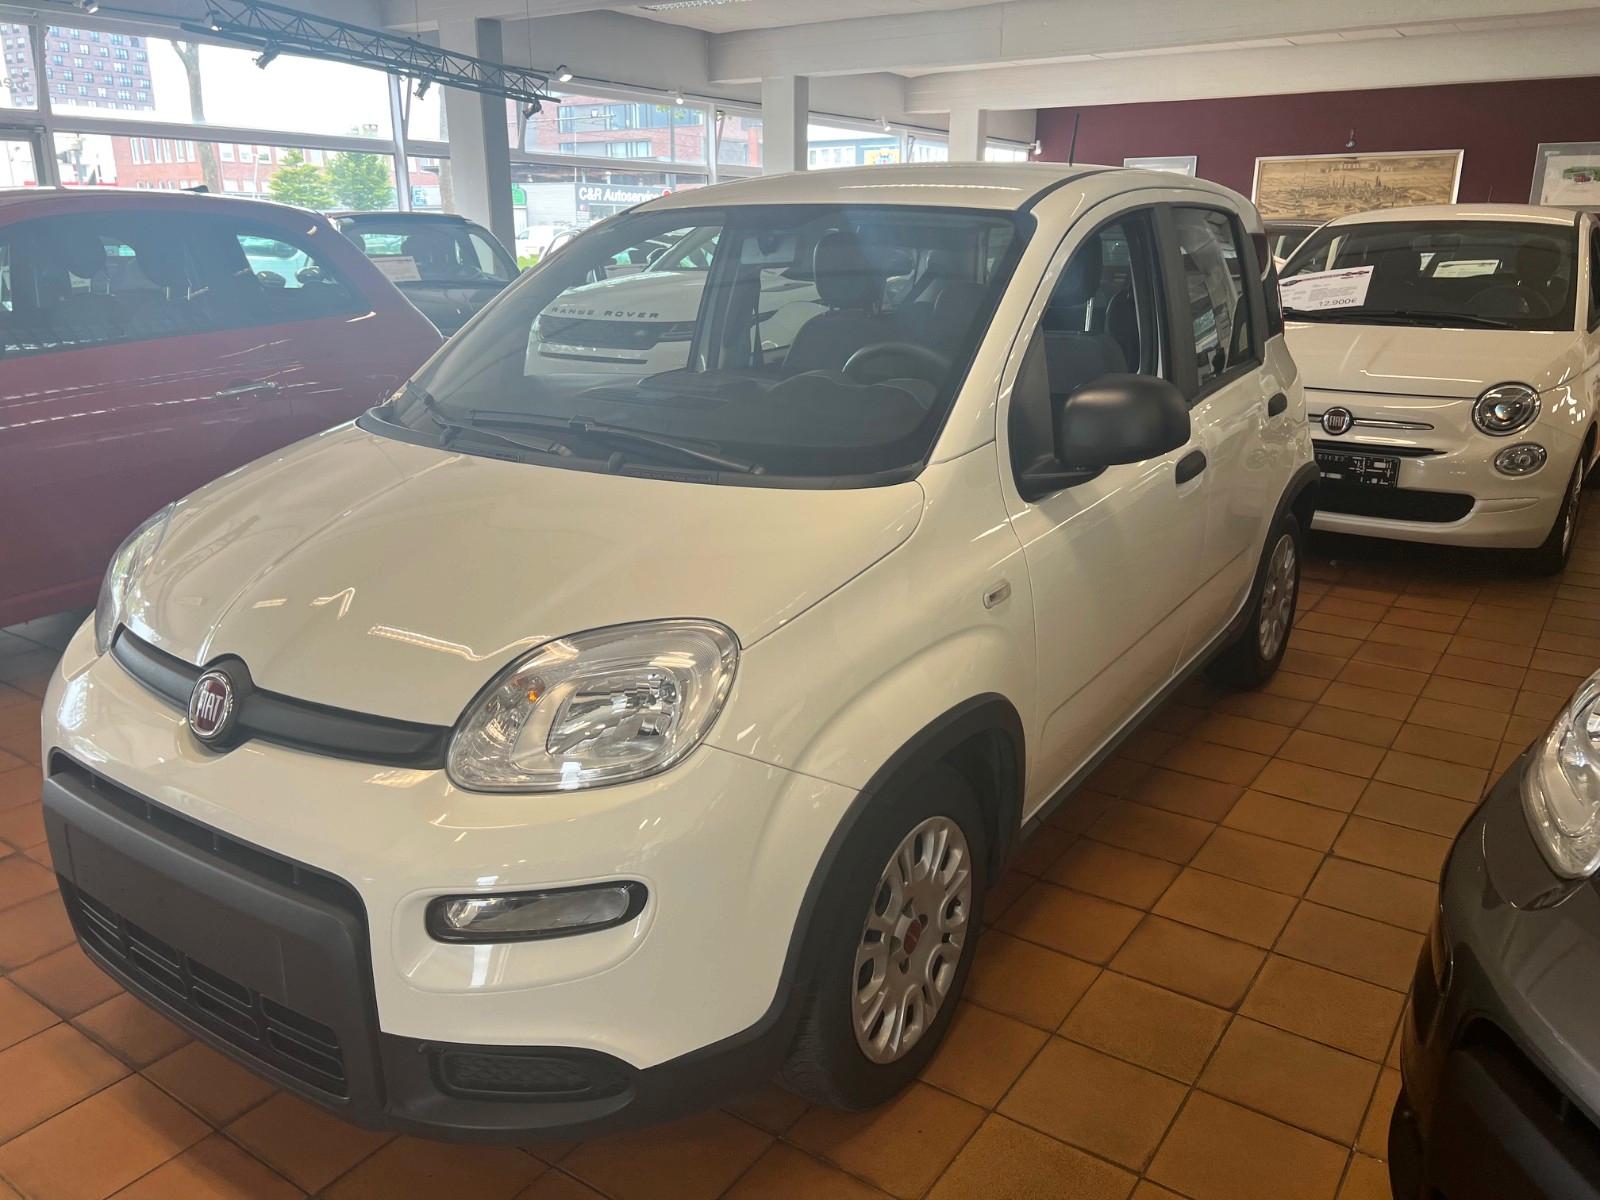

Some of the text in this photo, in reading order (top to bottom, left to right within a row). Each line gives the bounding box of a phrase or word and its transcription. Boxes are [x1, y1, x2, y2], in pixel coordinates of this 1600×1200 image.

[579, 187, 602, 201] C&R
[603, 310, 660, 319] ROVER
[196, 690, 224, 722] FIAT
